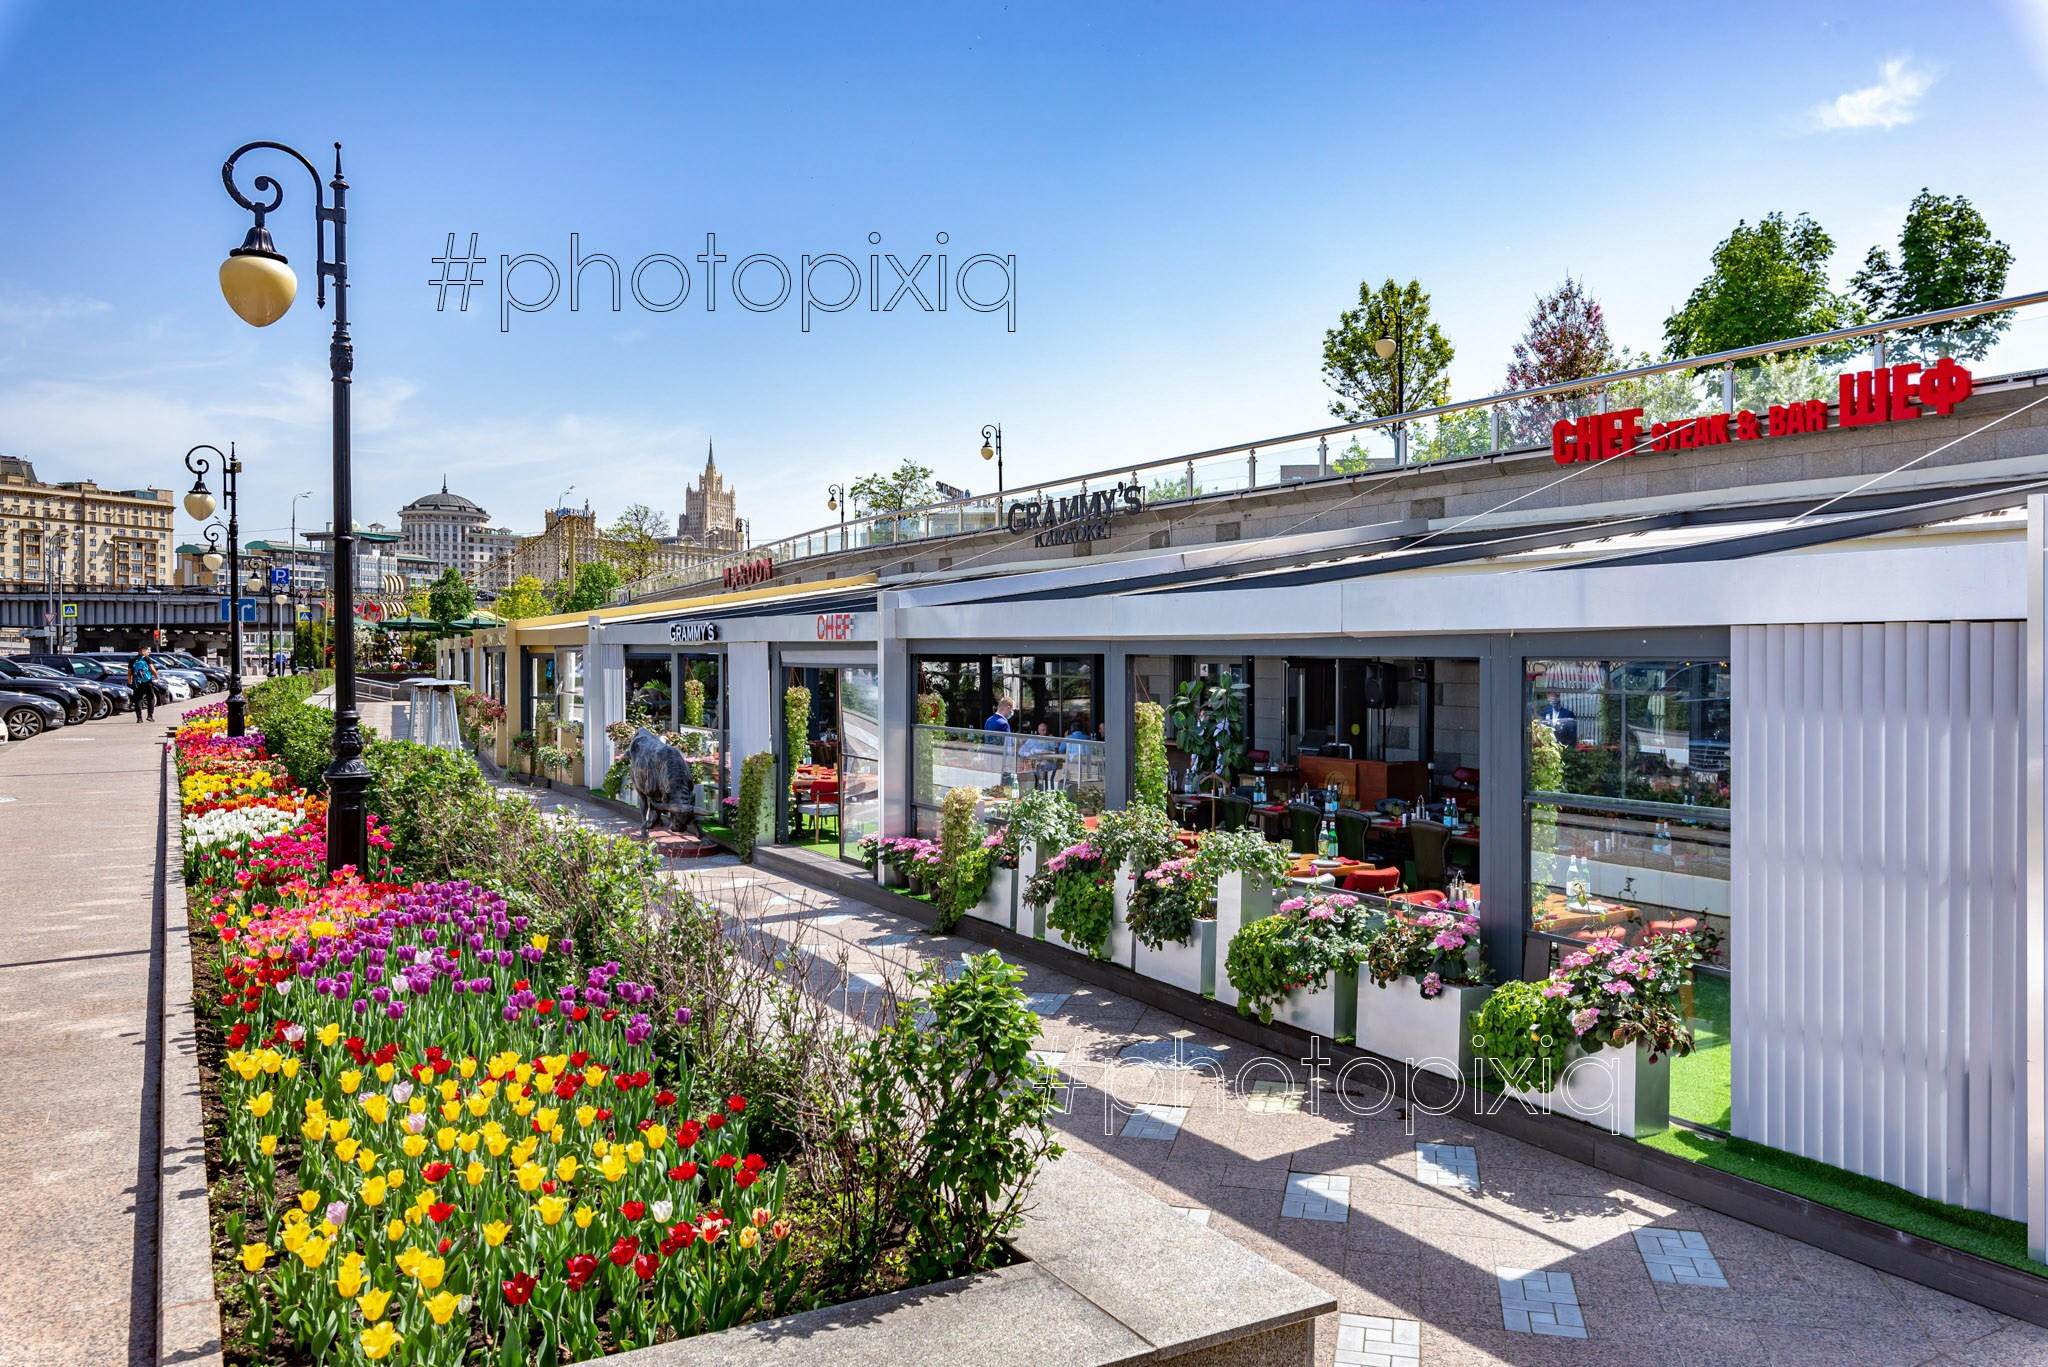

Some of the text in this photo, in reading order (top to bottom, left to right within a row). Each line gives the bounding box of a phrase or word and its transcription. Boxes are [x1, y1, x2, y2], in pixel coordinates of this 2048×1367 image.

[1552, 357, 1973, 465] CHEF STEAK & BAR ШЕФ
[1007, 482, 1144, 536] GRAMMY'S
[1034, 523, 1108, 548] KARAOKE
[669, 622, 716, 642] GRAMMY'S
[817, 614, 854, 640] CHEF
